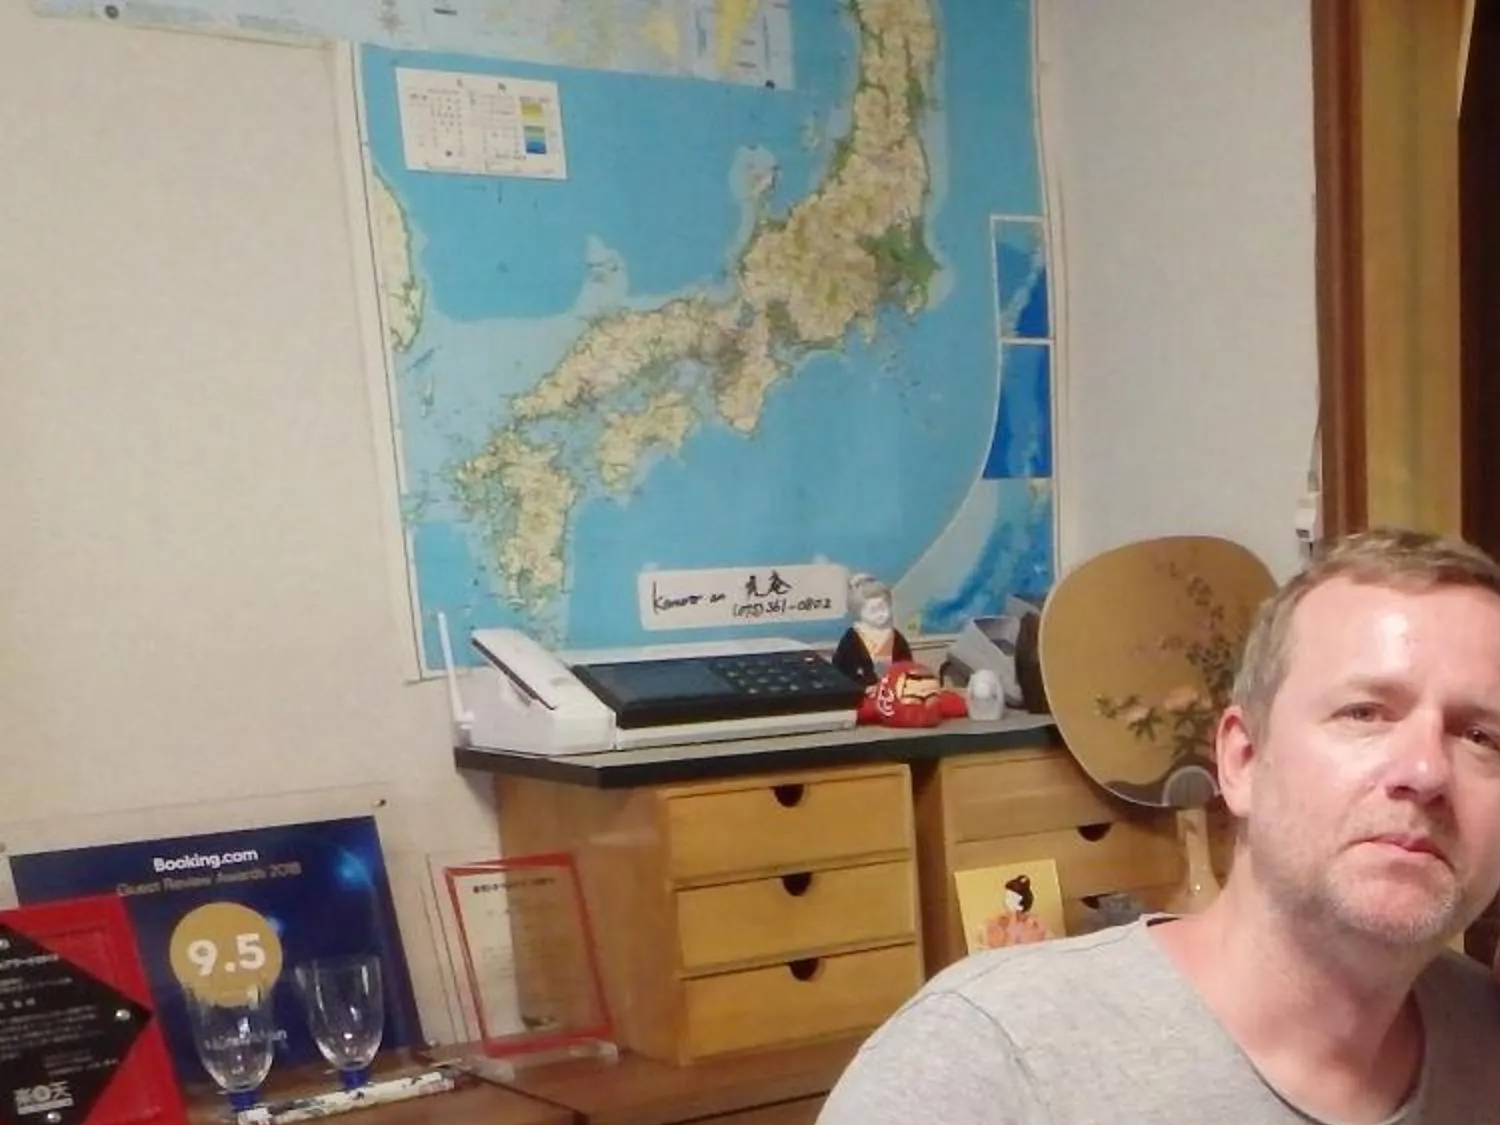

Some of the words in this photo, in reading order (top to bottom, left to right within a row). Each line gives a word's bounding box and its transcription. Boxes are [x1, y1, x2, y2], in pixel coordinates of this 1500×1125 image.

[153, 850, 259, 873] Booking.com
[116, 882, 162, 897] Guest
[163, 875, 212, 892] Review
[215, 868, 267, 886] Awards
[187, 932, 266, 976] 9.5
